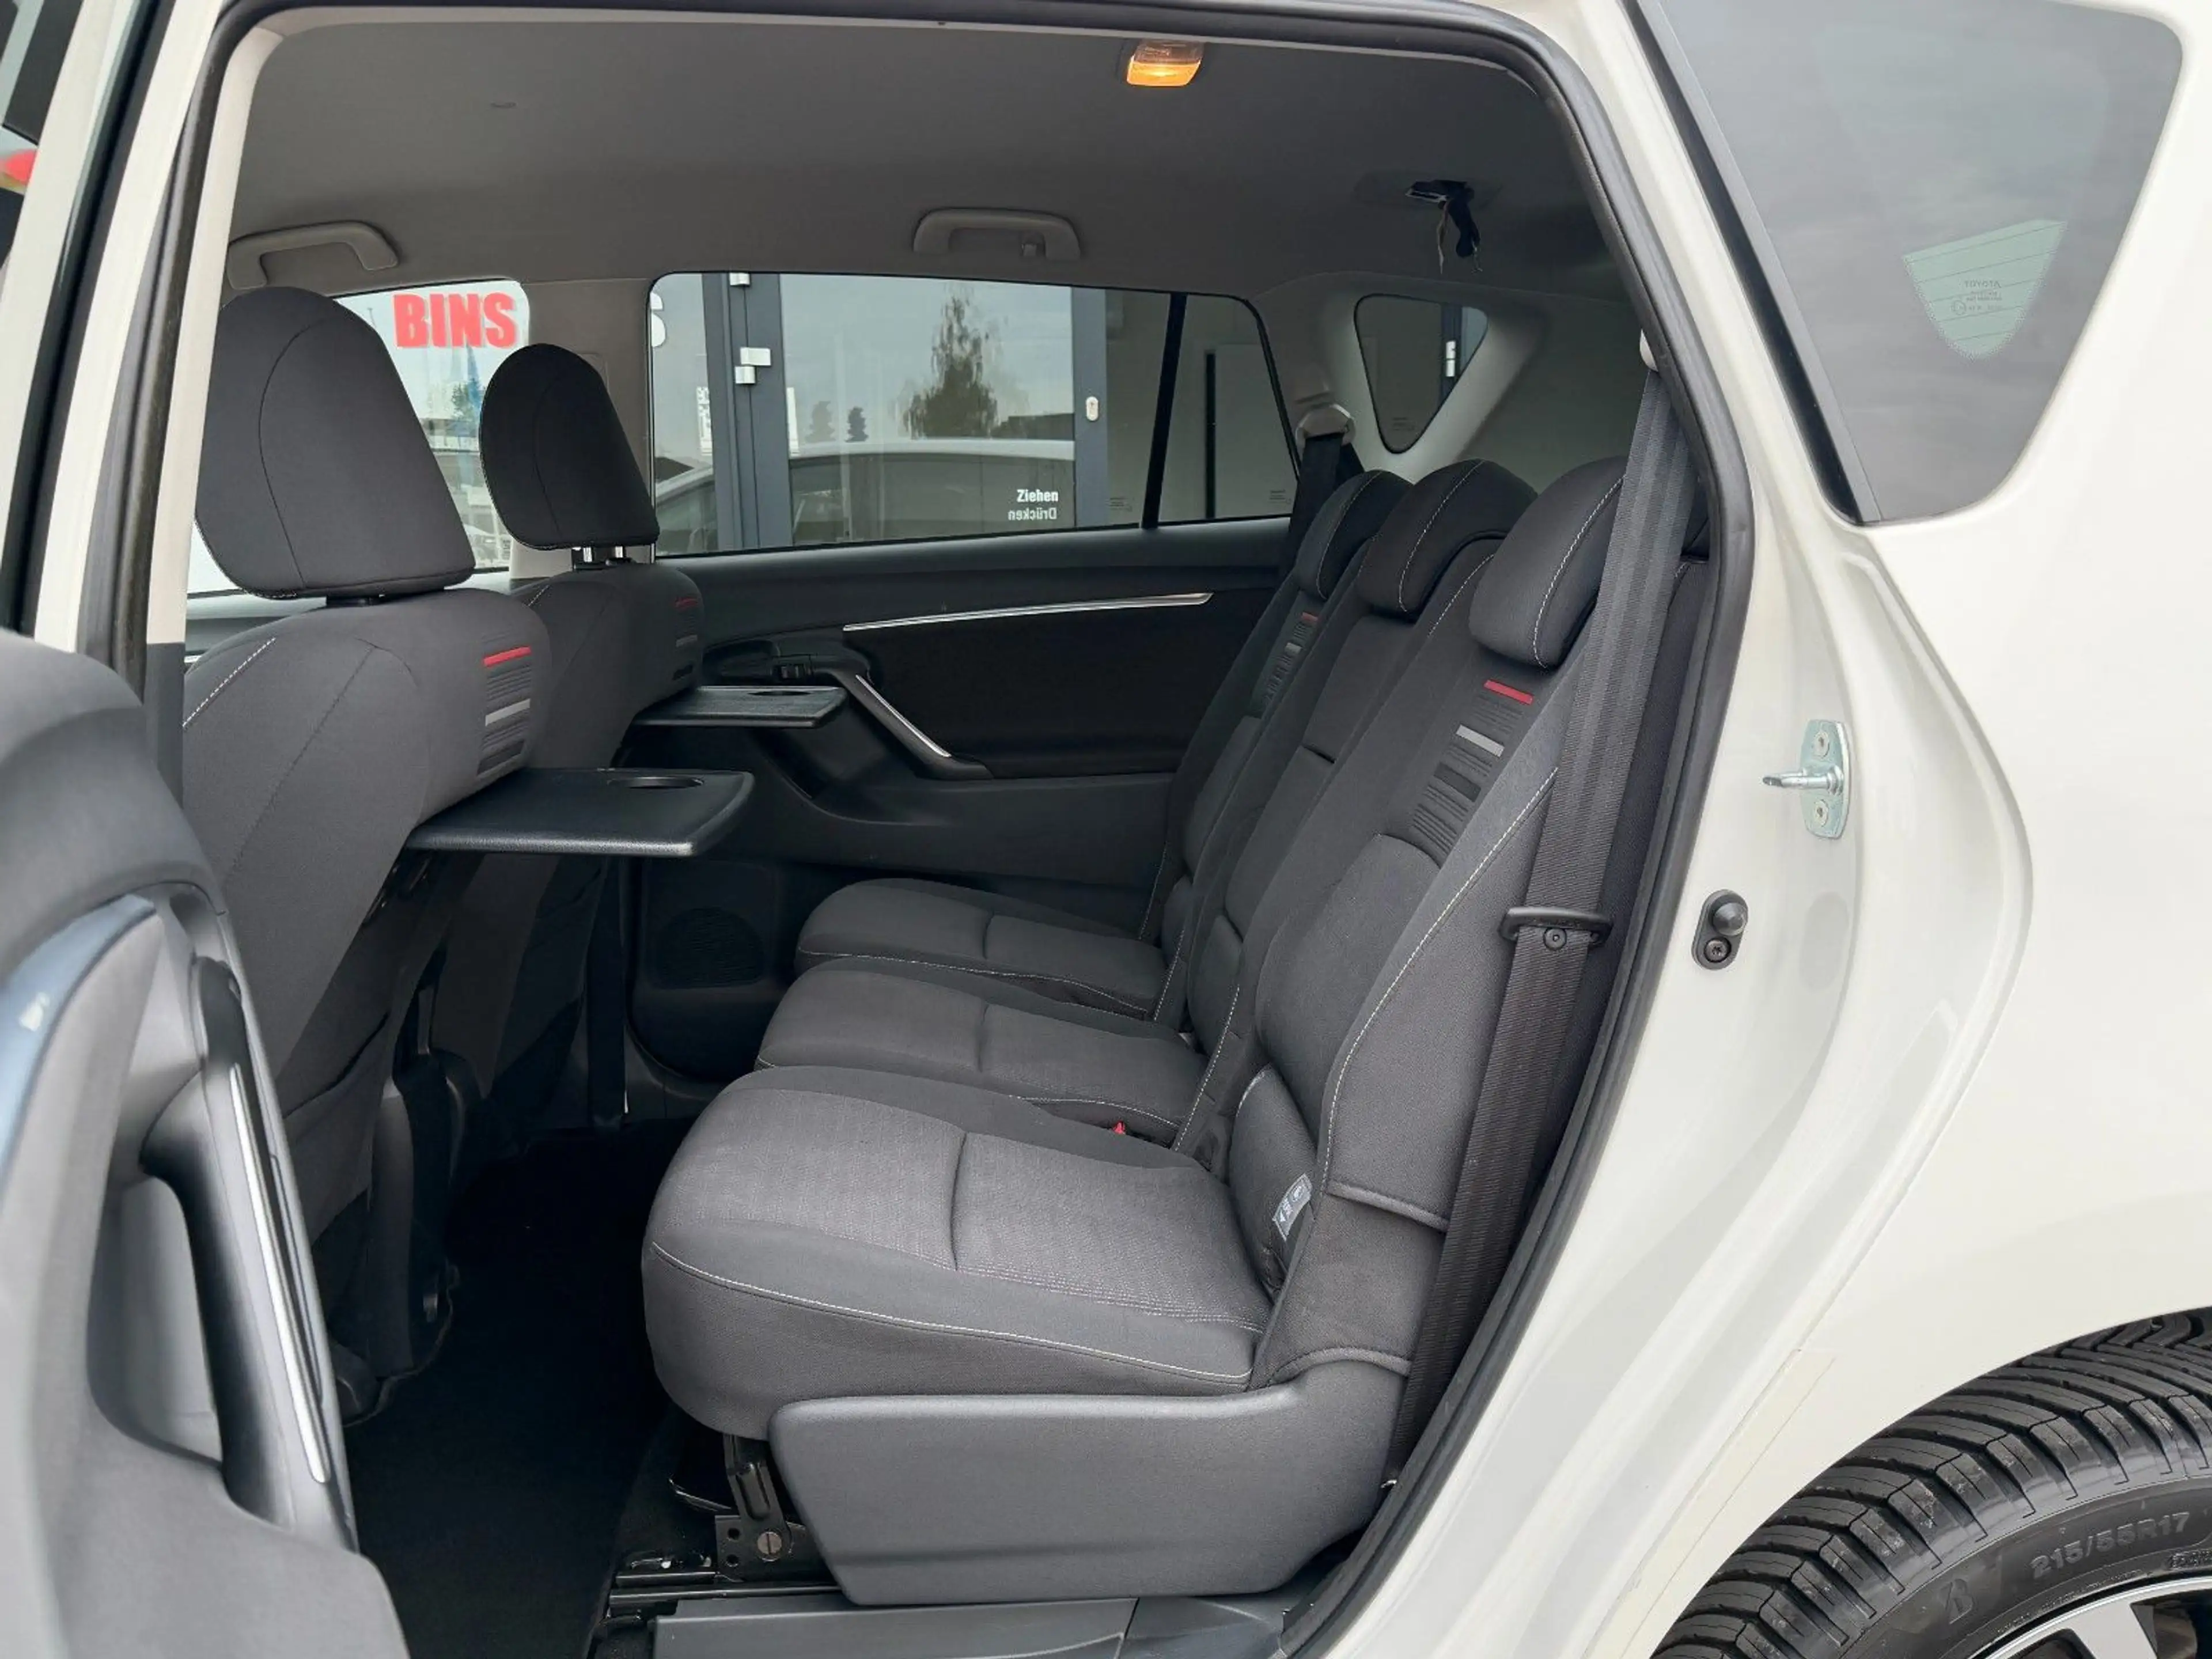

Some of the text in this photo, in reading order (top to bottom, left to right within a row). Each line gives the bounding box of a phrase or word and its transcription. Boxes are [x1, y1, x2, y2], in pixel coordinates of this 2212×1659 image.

[1964, 280, 2001, 288] TOYOTA
[393, 292, 517, 349] BINS
[1017, 488, 1059, 502] Ziehen
[2029, 1512, 2189, 1580] 215/55R17
